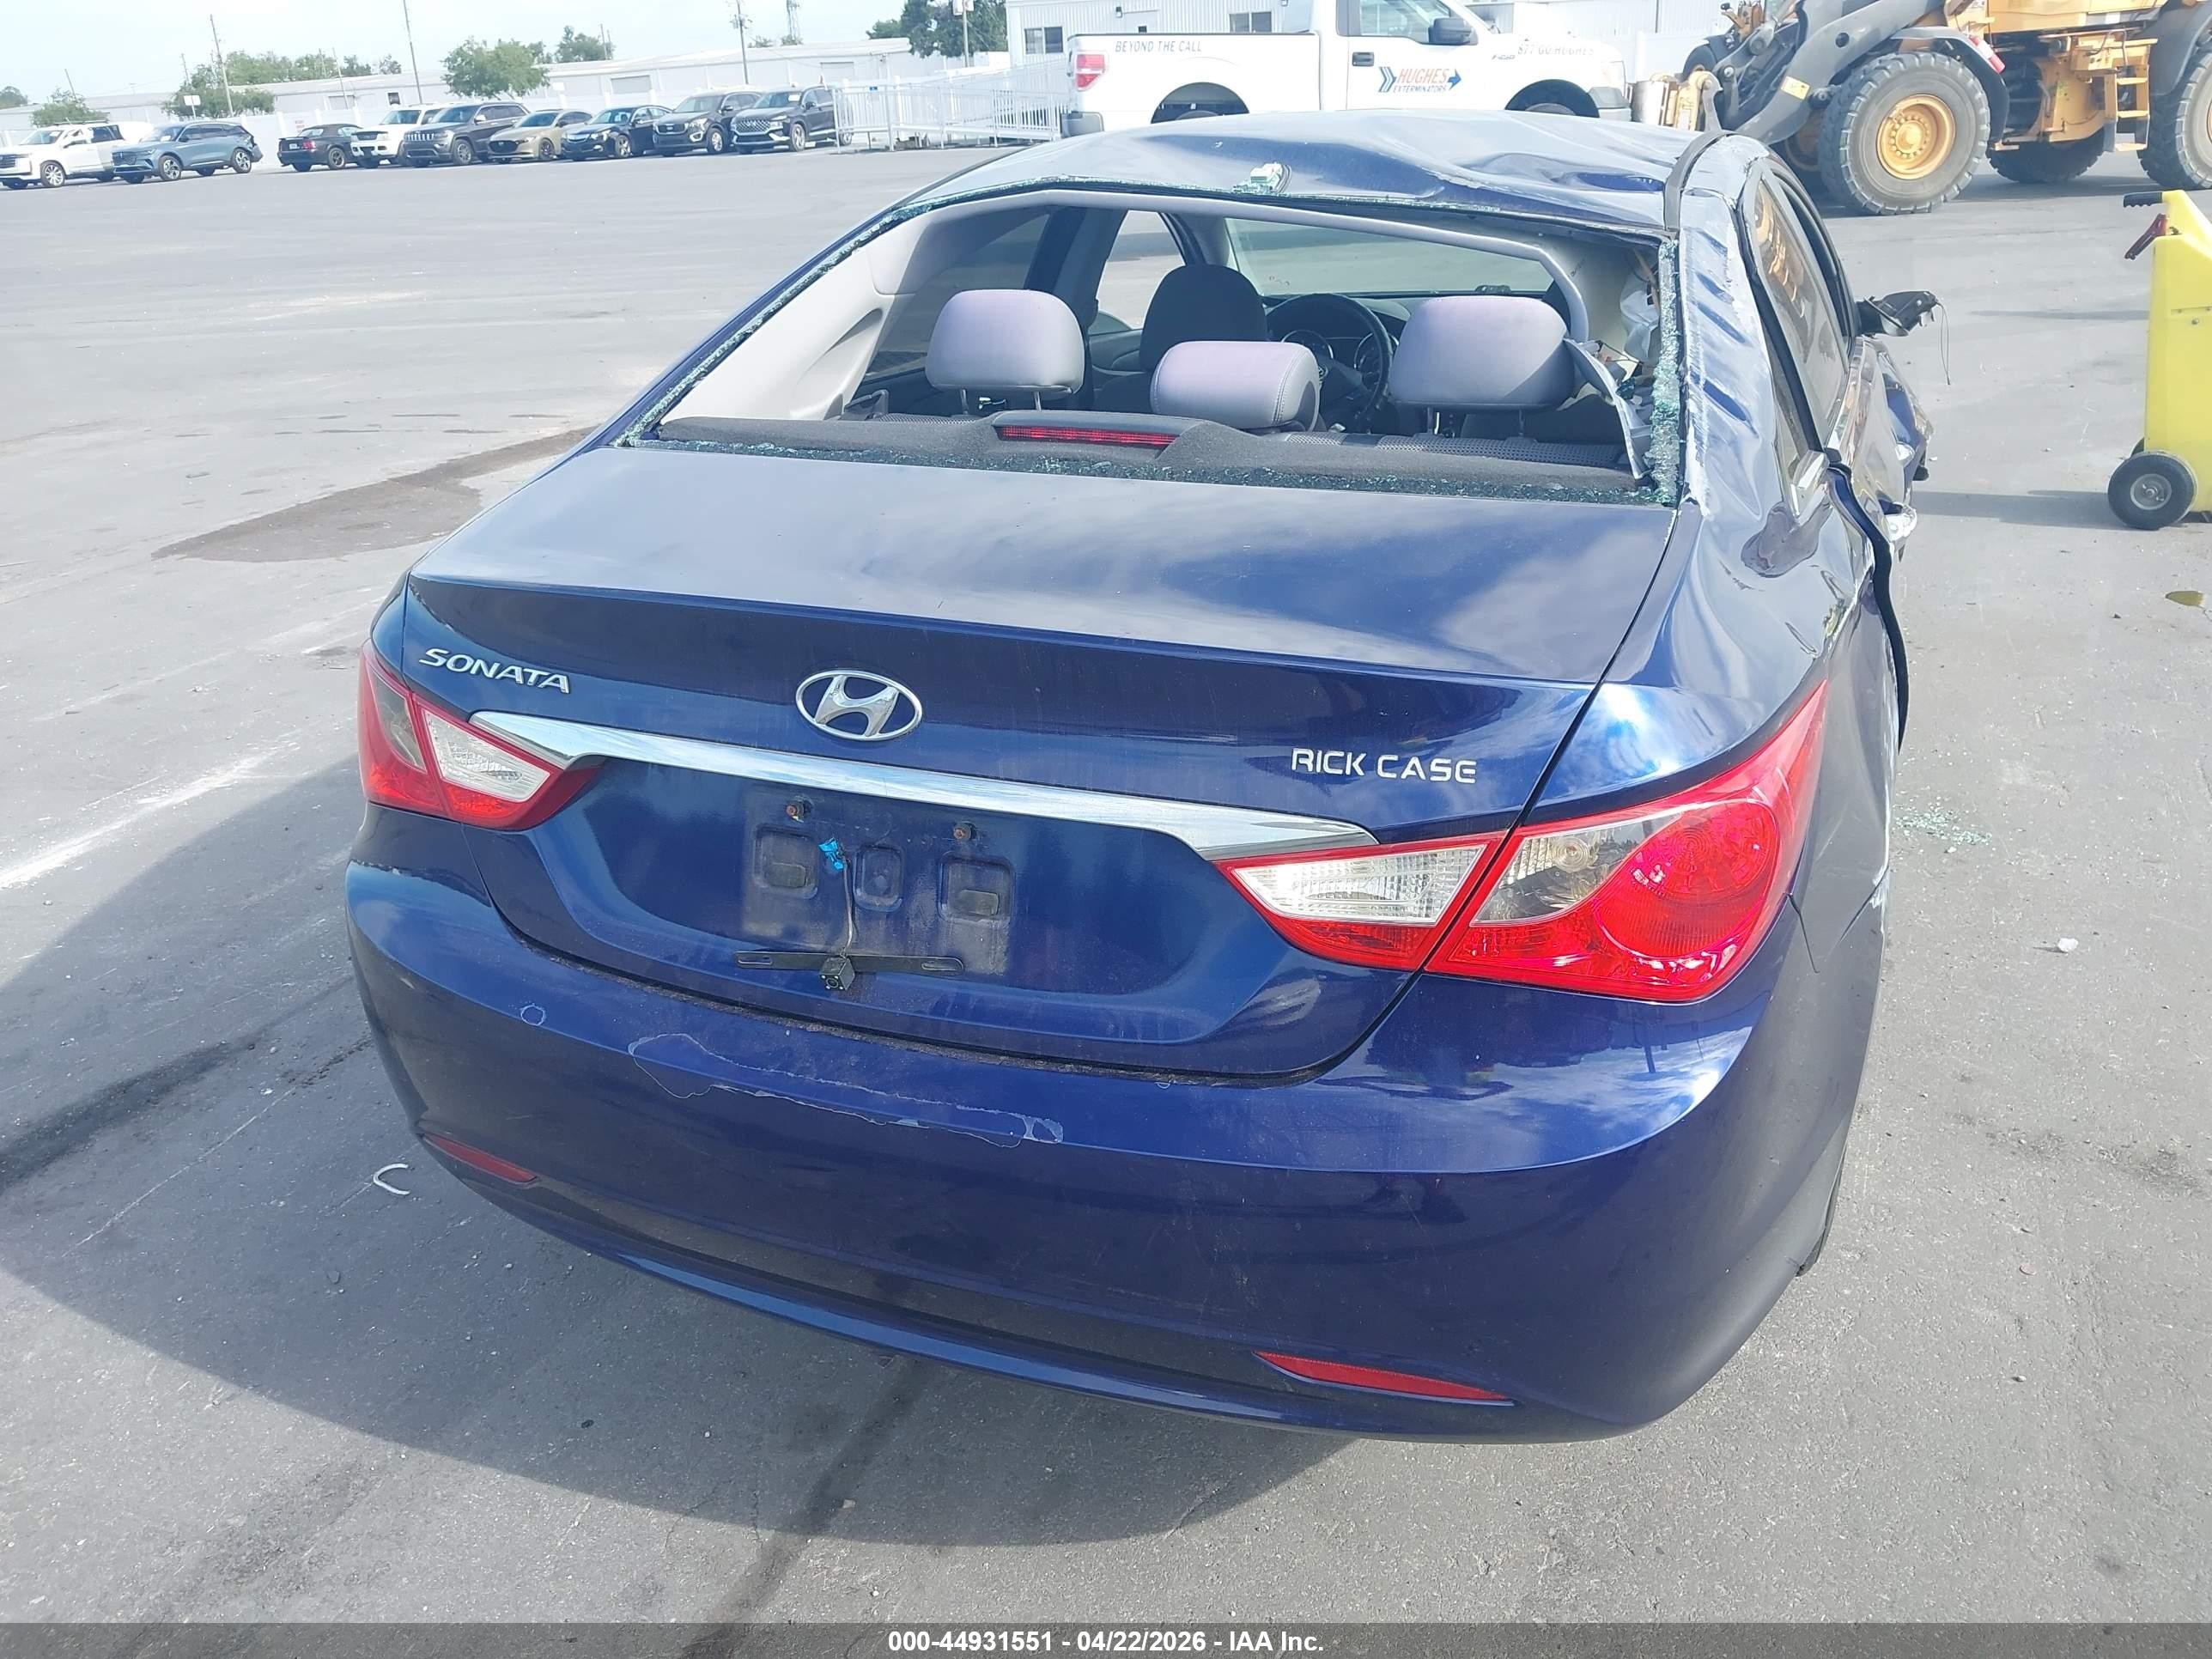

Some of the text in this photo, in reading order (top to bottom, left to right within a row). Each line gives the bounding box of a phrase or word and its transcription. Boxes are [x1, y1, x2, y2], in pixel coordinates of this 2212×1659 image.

[1115, 40, 1202, 52] BEYOND THE CALL
[1397, 68, 1449, 84] HUGHES
[1394, 85, 1447, 94] EXTERMINATORS
[418, 647, 570, 695] SONATA
[1291, 747, 1477, 784] RICK CASE
